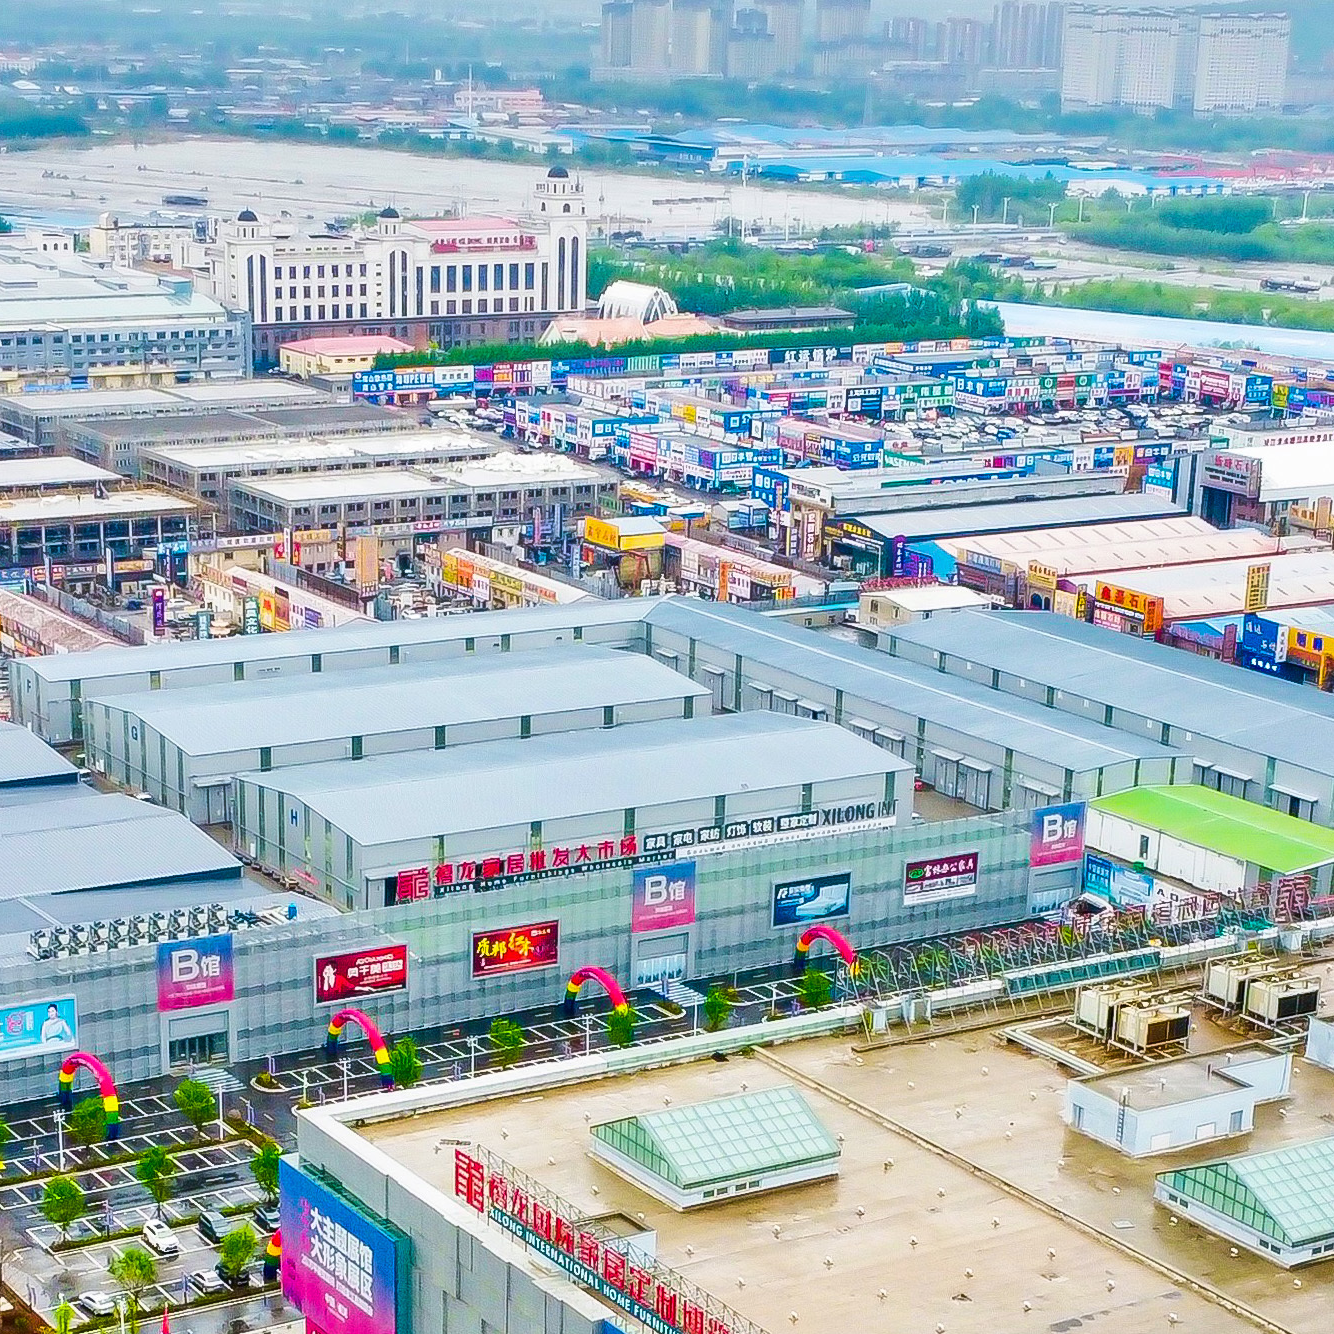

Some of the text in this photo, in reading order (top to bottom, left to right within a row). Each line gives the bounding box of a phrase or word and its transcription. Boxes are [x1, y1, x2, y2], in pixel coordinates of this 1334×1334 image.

[644, 874, 686, 907] B馆
[171, 948, 221, 984] B馆
[525, 1229, 601, 1290] INTERNATIONAL
[603, 1283, 631, 1311] HOME
